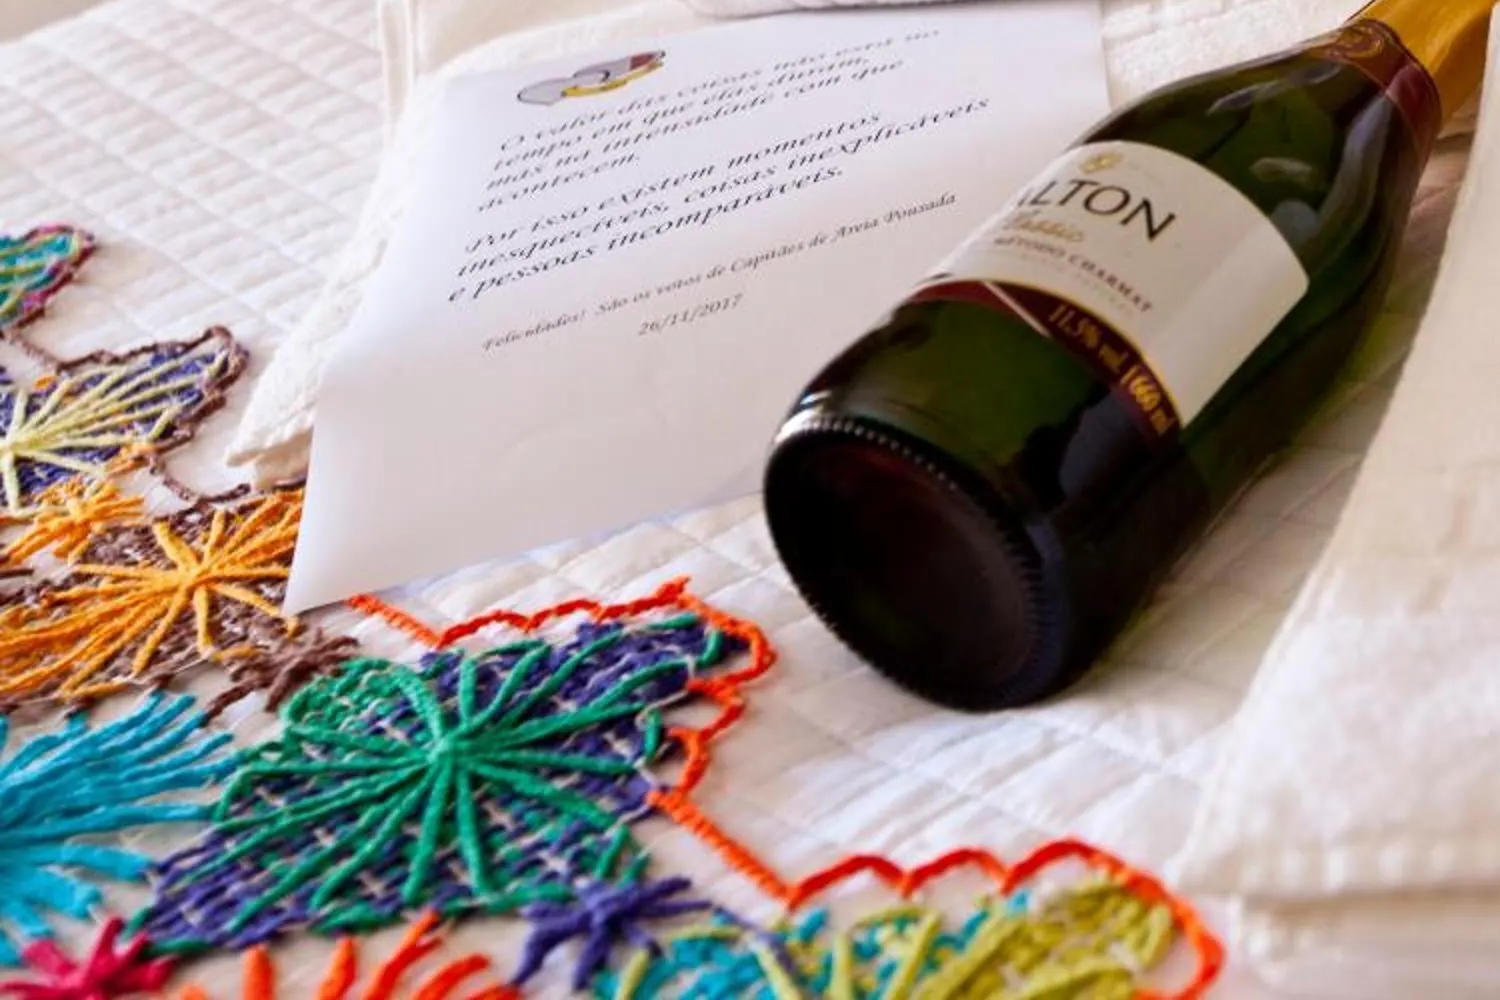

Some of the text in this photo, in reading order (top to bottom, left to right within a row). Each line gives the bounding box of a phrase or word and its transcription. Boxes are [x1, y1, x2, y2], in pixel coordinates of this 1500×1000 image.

[457, 97, 990, 278] inesquecíveis, coisas inexplicáveis
[465, 111, 881, 252] Por isso existem momentos
[477, 152, 641, 213] acontecem.
[486, 60, 905, 191] mas na intensidade com que
[494, 136, 583, 170] tempo
[591, 119, 634, 140] em
[642, 101, 694, 126] que
[703, 83, 758, 106] elas
[448, 165, 843, 302] e pessoas incomparáveis.
[595, 296, 629, 316] São
[632, 290, 652, 304] os
[656, 275, 703, 297] votos
[706, 263, 727, 280] de
[730, 241, 805, 273] Capitães
[808, 231, 829, 249] de
[829, 220, 880, 243] Areia
[882, 192, 957, 223] Pousada
[638, 292, 744, 337] 26/11/2017
